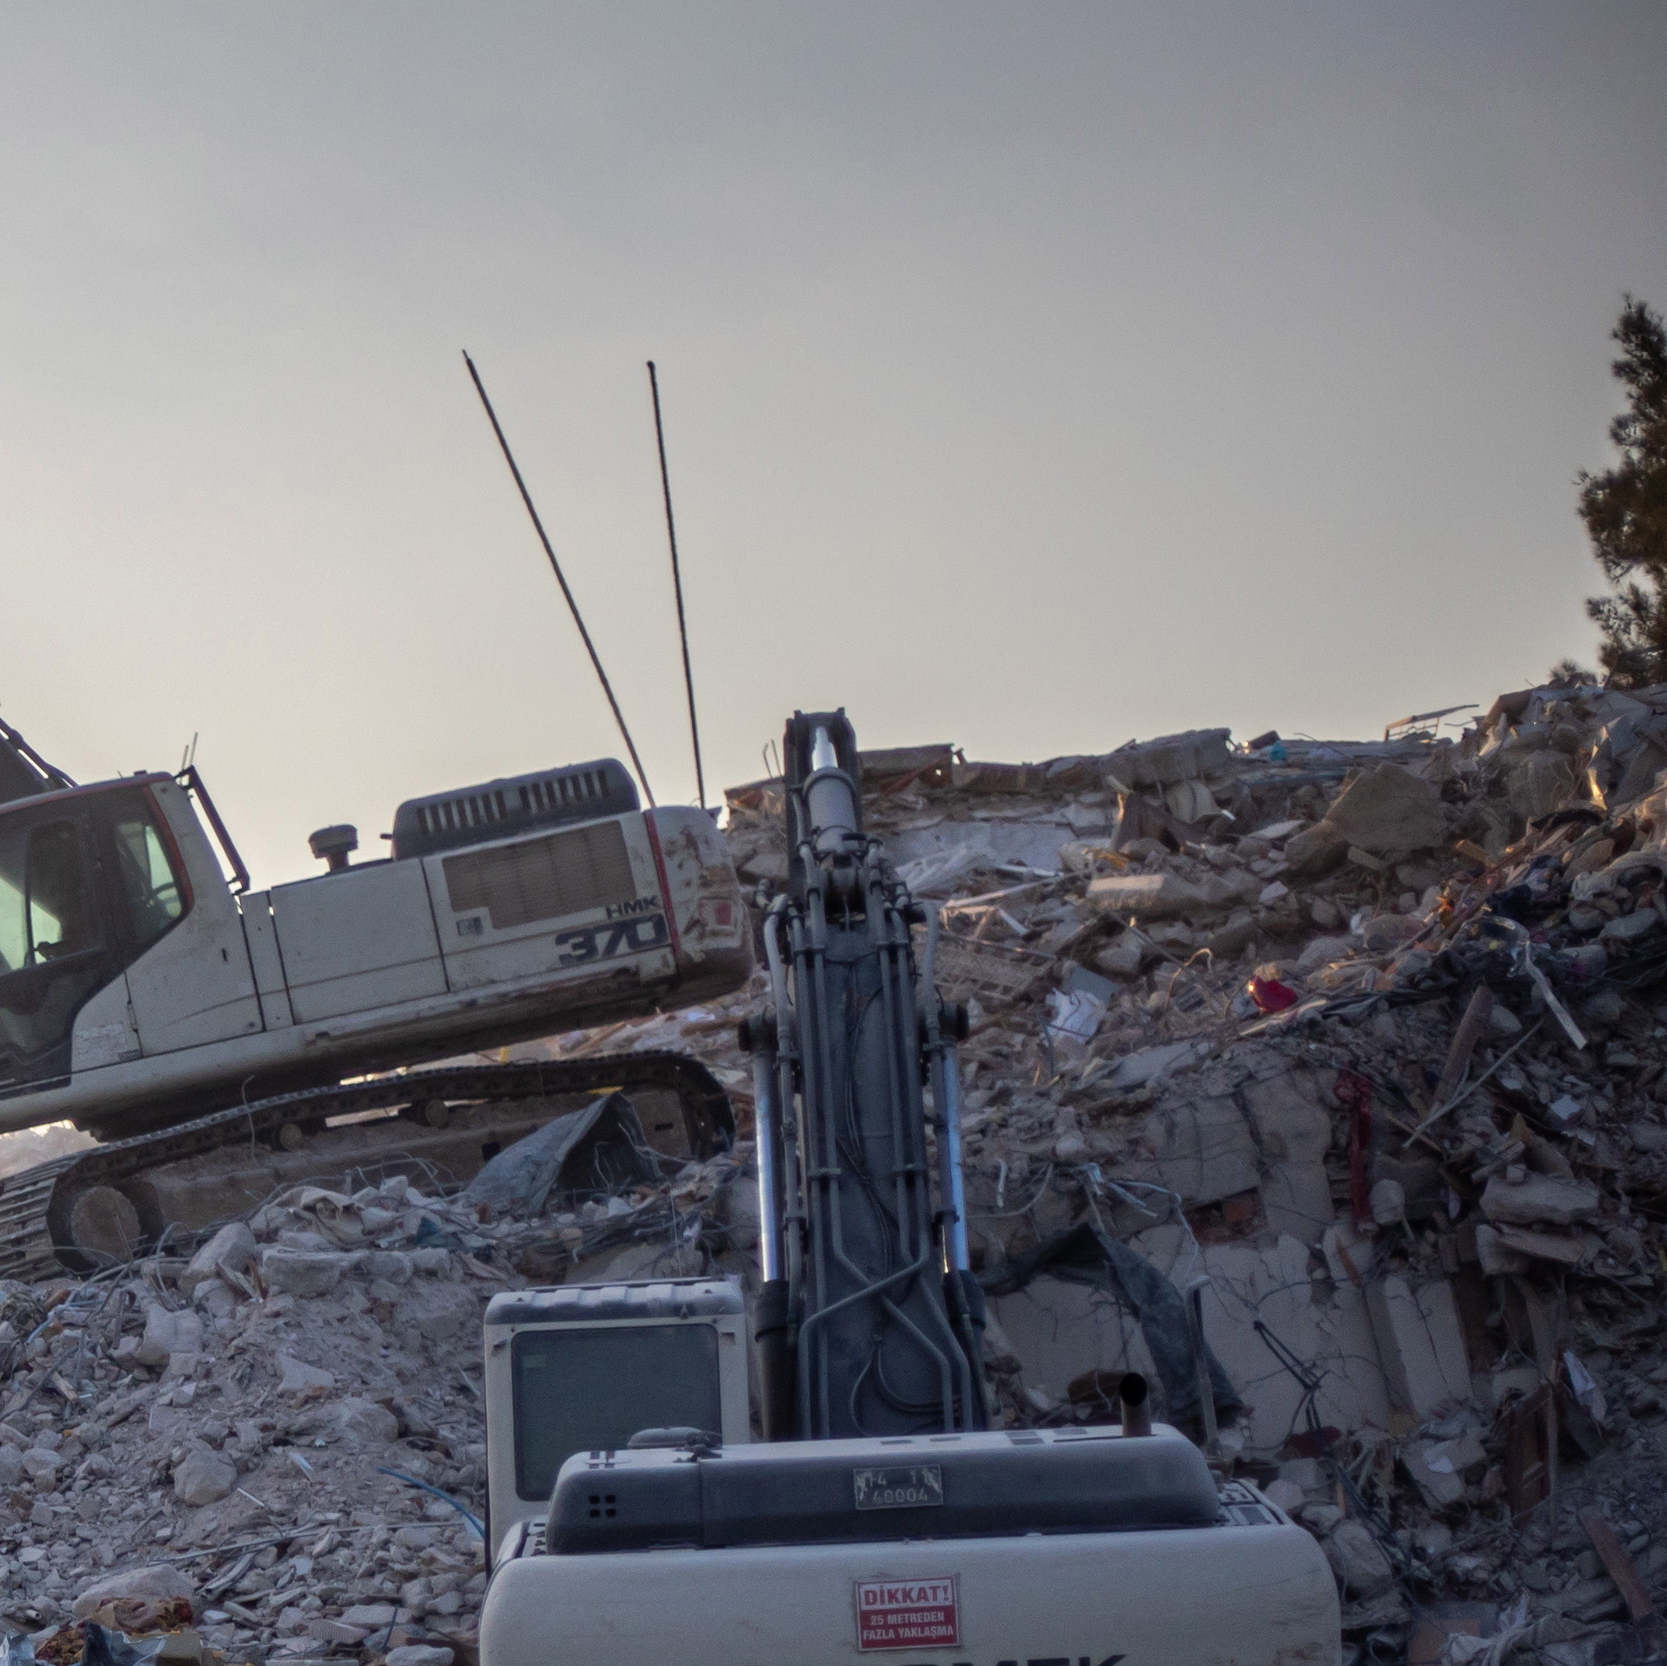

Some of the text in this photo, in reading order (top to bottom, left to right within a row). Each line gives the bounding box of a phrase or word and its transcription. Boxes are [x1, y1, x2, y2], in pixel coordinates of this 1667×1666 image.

[605, 895, 660, 920] HMK
[554, 912, 669, 966] 370
[863, 1584, 950, 1607] DİKKAT!
[870, 1611, 945, 1626] 25 METREDEN
[863, 1624, 954, 1640] FAZLA YAKLAŞMA
